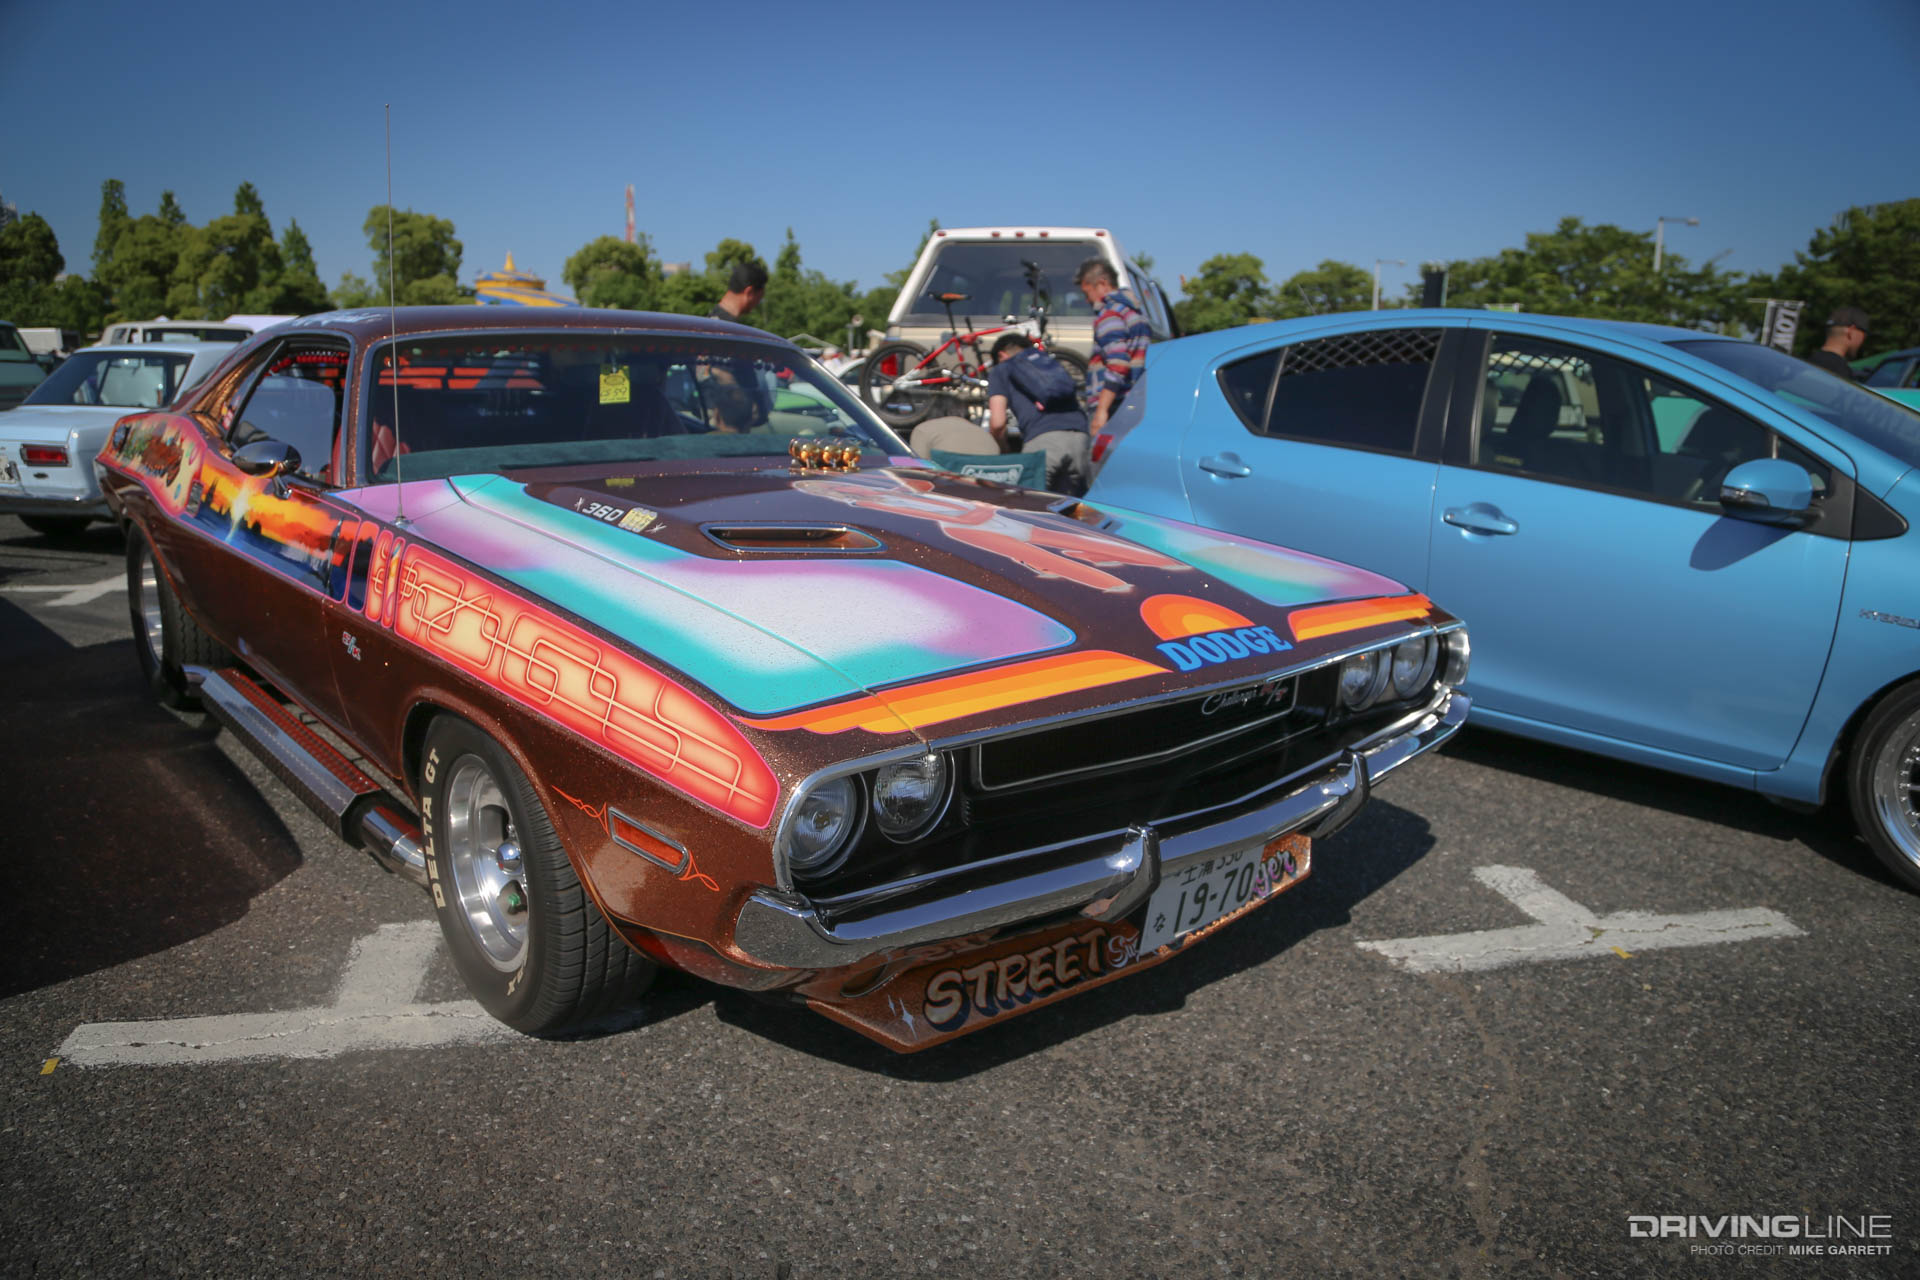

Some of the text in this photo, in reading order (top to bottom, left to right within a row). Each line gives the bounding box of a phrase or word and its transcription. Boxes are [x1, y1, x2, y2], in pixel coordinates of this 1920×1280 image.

[582, 502, 624, 521] 360
[1156, 625, 1294, 672] DODGE
[423, 748, 446, 908] DELTA GT
[1173, 862, 1255, 934] 19-70
[923, 927, 1108, 1029] STREET
